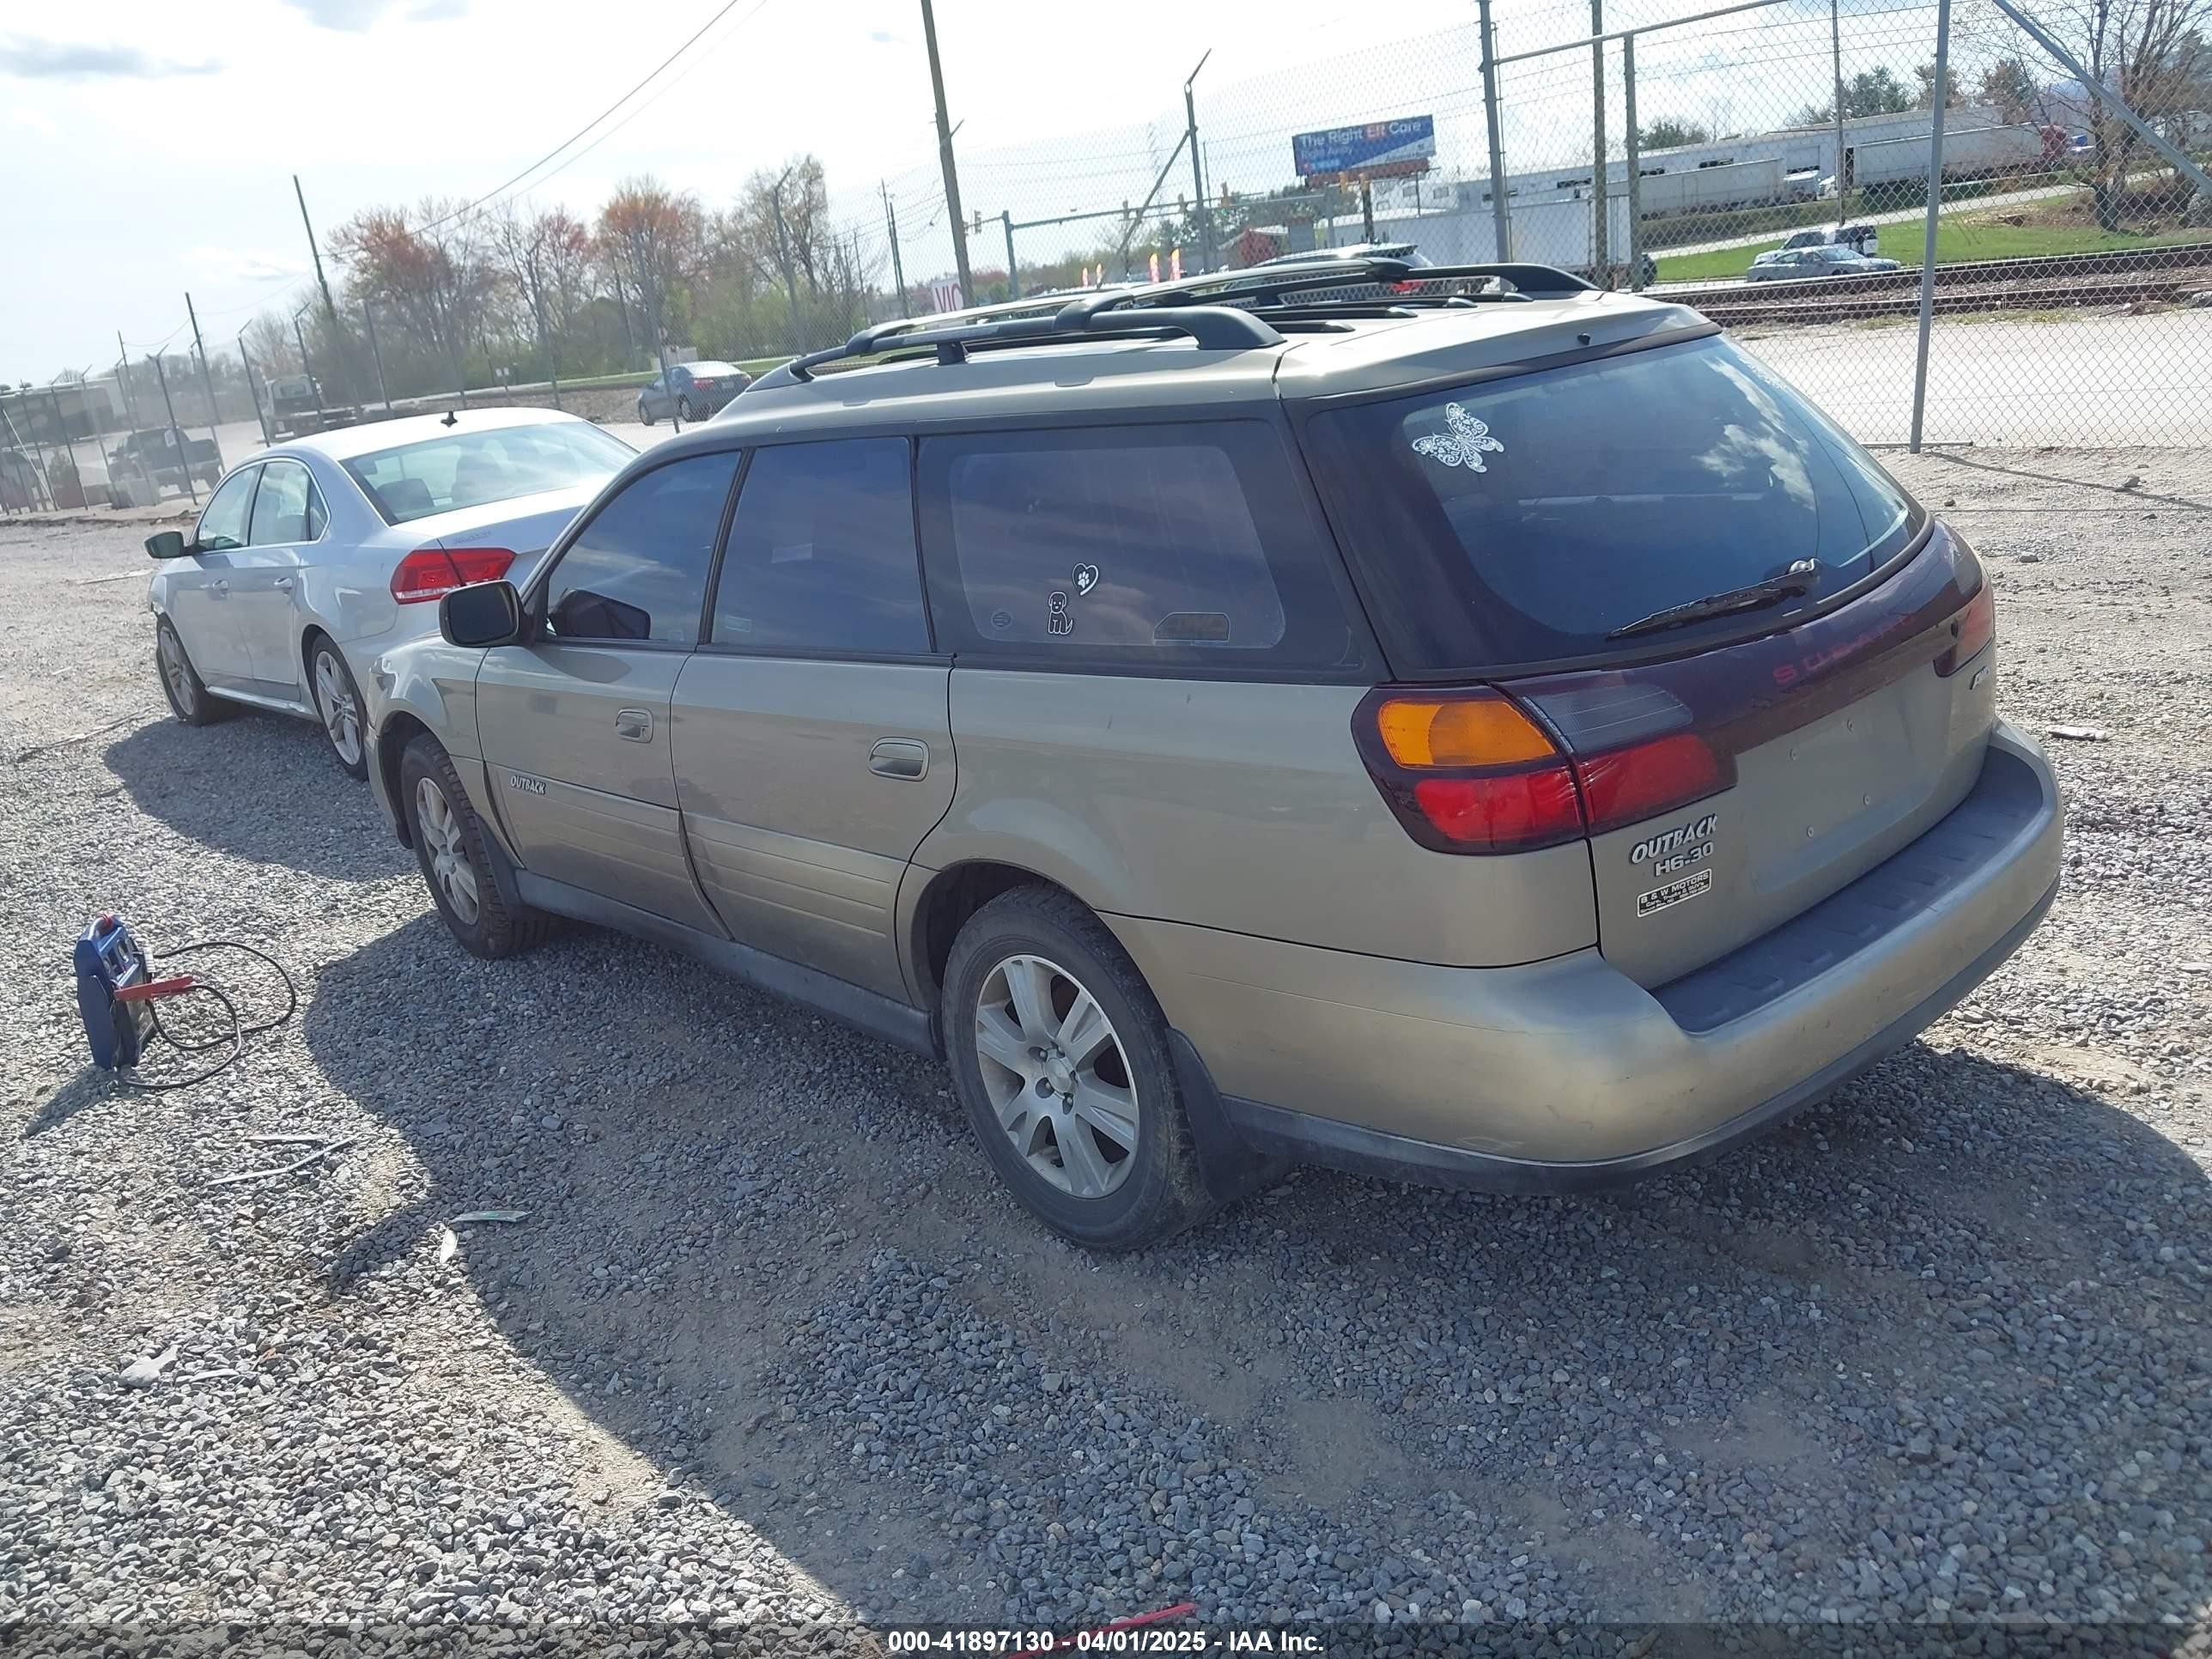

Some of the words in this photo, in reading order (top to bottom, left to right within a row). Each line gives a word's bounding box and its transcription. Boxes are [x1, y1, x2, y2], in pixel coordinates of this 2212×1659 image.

[1298, 134, 1325, 148] The
[1328, 128, 1364, 145] Right
[1366, 124, 1386, 138] ER
[1389, 121, 1422, 135] Care
[509, 775, 547, 795] OUTBACK
[1631, 813, 1717, 864] OUTBACK
[1640, 896, 1648, 904] B
[1660, 888, 1669, 896] W
[1671, 872, 1709, 893] MOTORS
